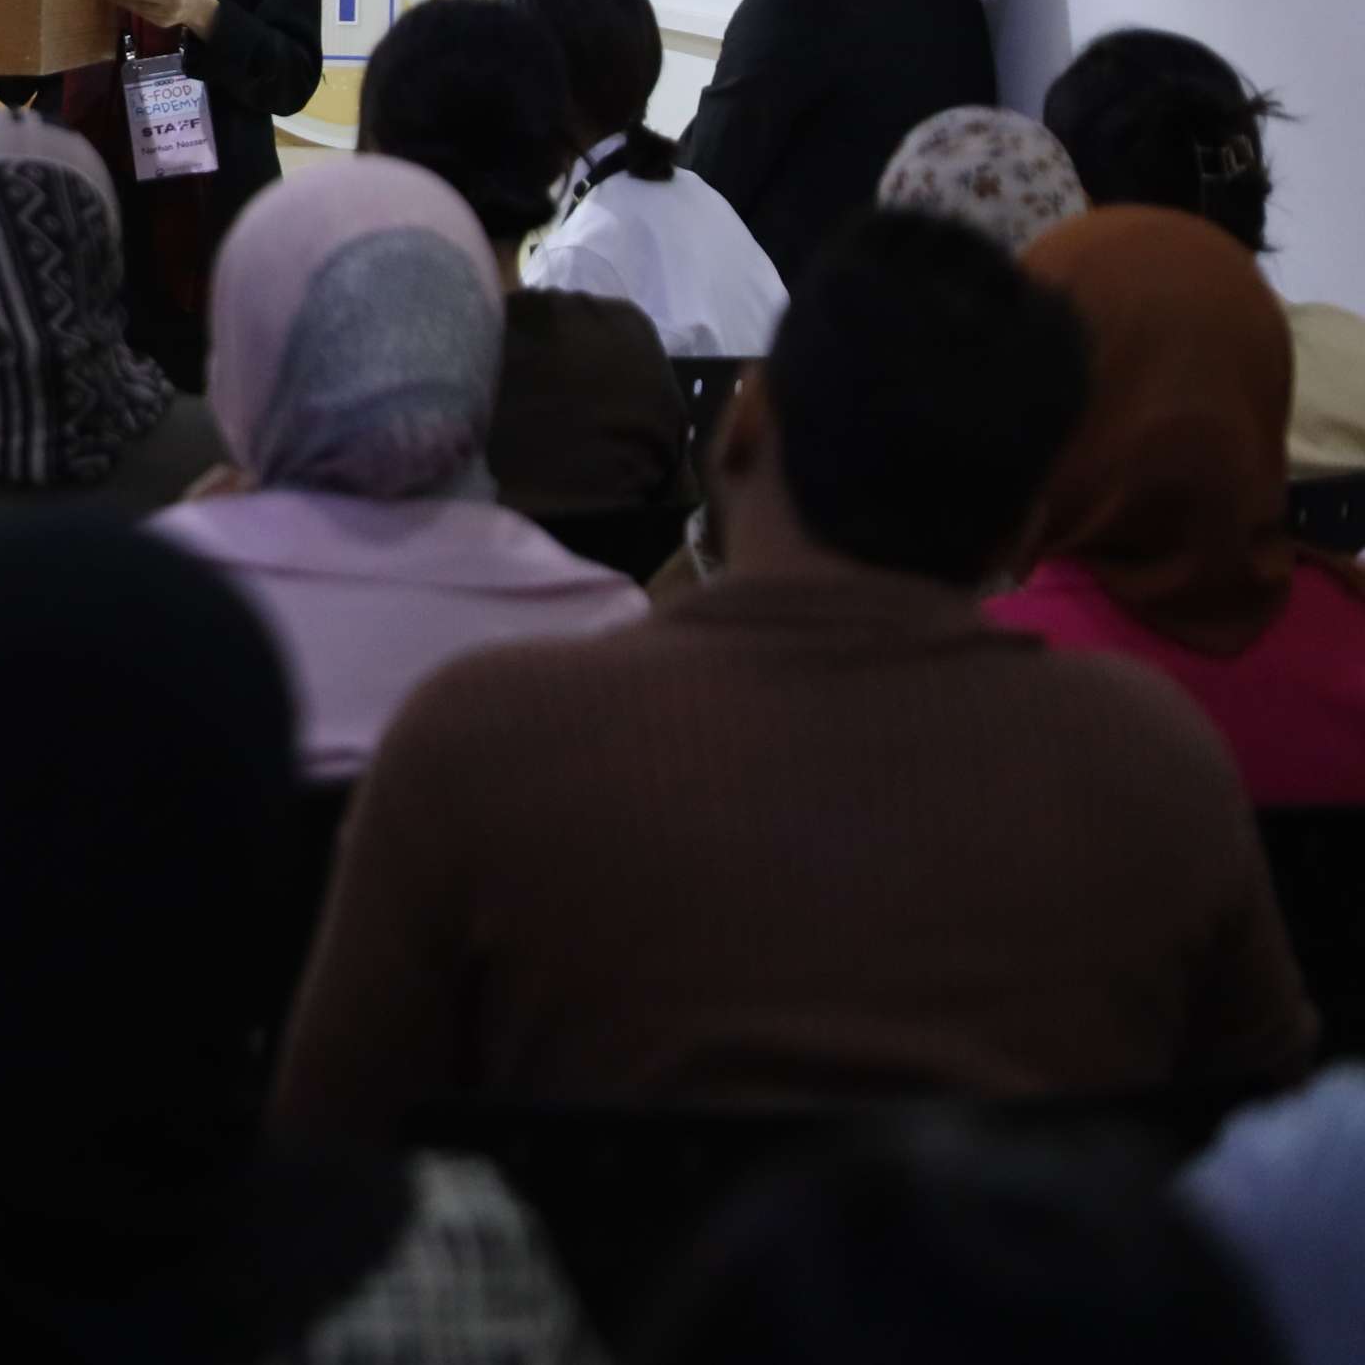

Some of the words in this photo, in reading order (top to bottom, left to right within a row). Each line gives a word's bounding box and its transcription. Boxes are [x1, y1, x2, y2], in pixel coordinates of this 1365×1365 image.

[140, 85, 193, 101] K-FOOD
[135, 97, 200, 115] ACADEMY
[141, 118, 201, 137] STAFF
